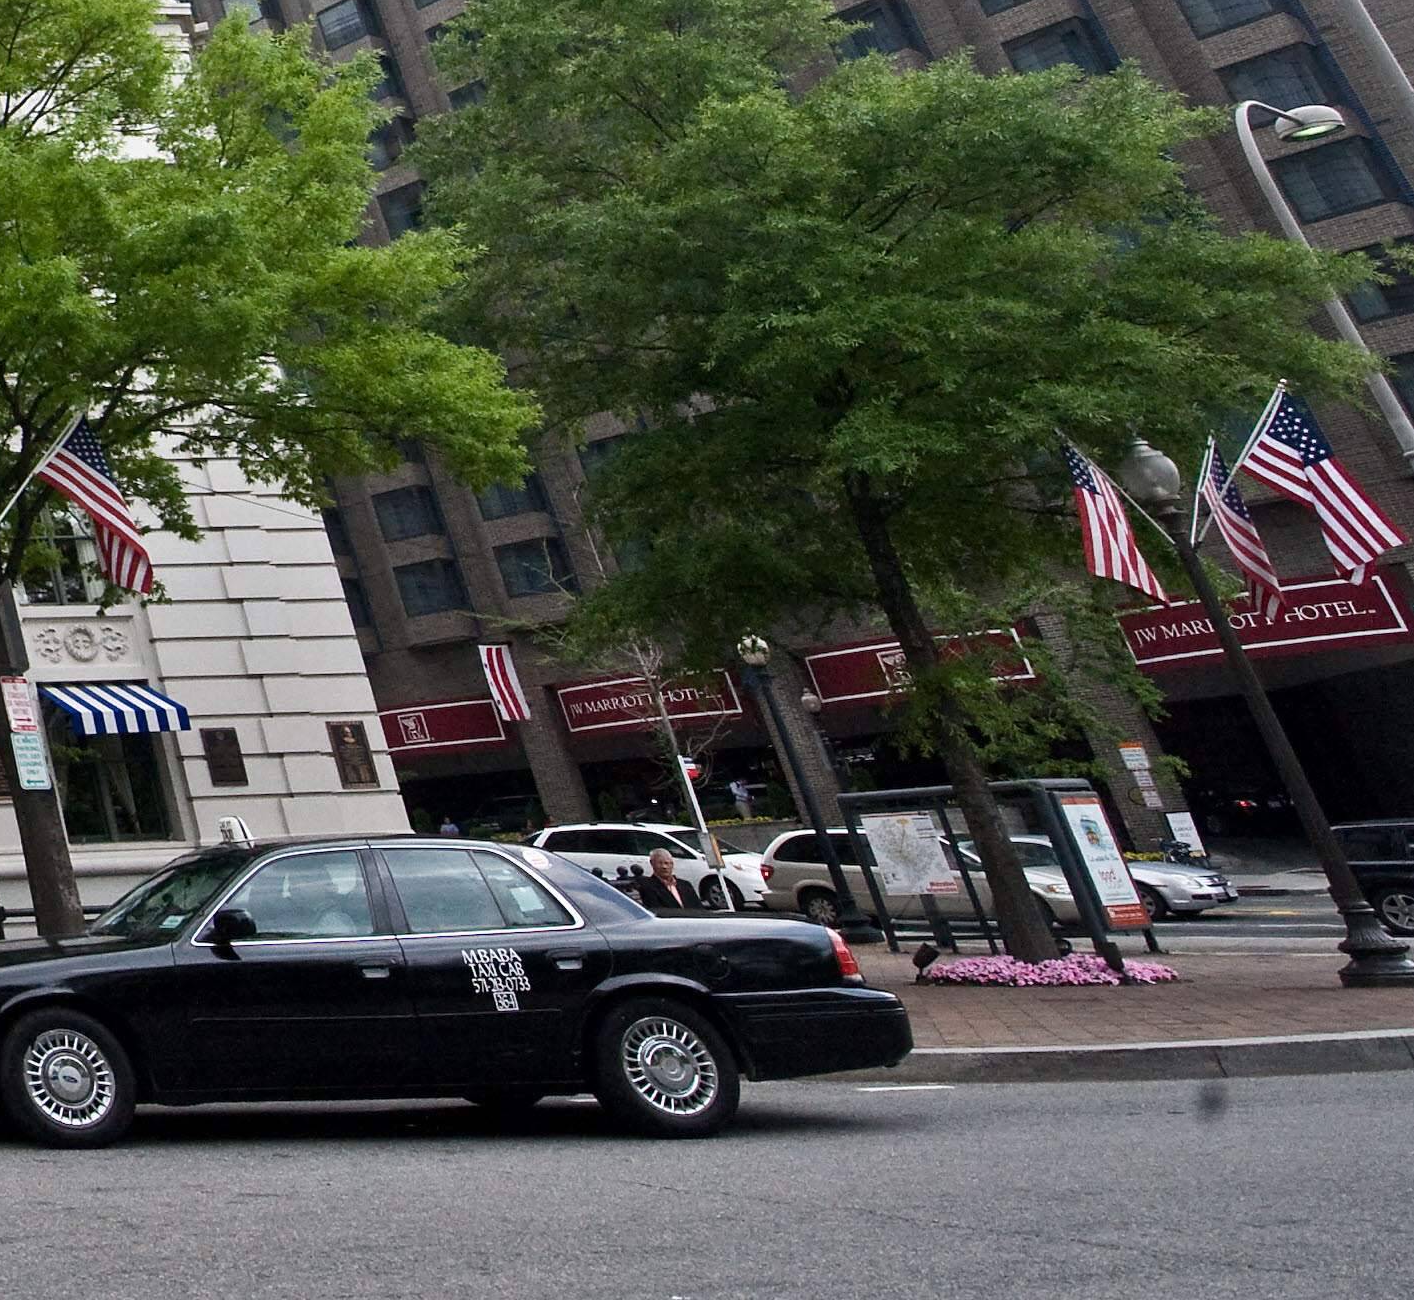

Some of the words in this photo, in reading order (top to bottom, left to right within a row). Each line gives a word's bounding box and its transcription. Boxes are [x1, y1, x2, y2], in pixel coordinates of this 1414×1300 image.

[1134, 627, 1156, 648] JW
[1284, 601, 1366, 622] HOTEL
[469, 963, 498, 978] TAXI
[499, 961, 525, 976] CAB
